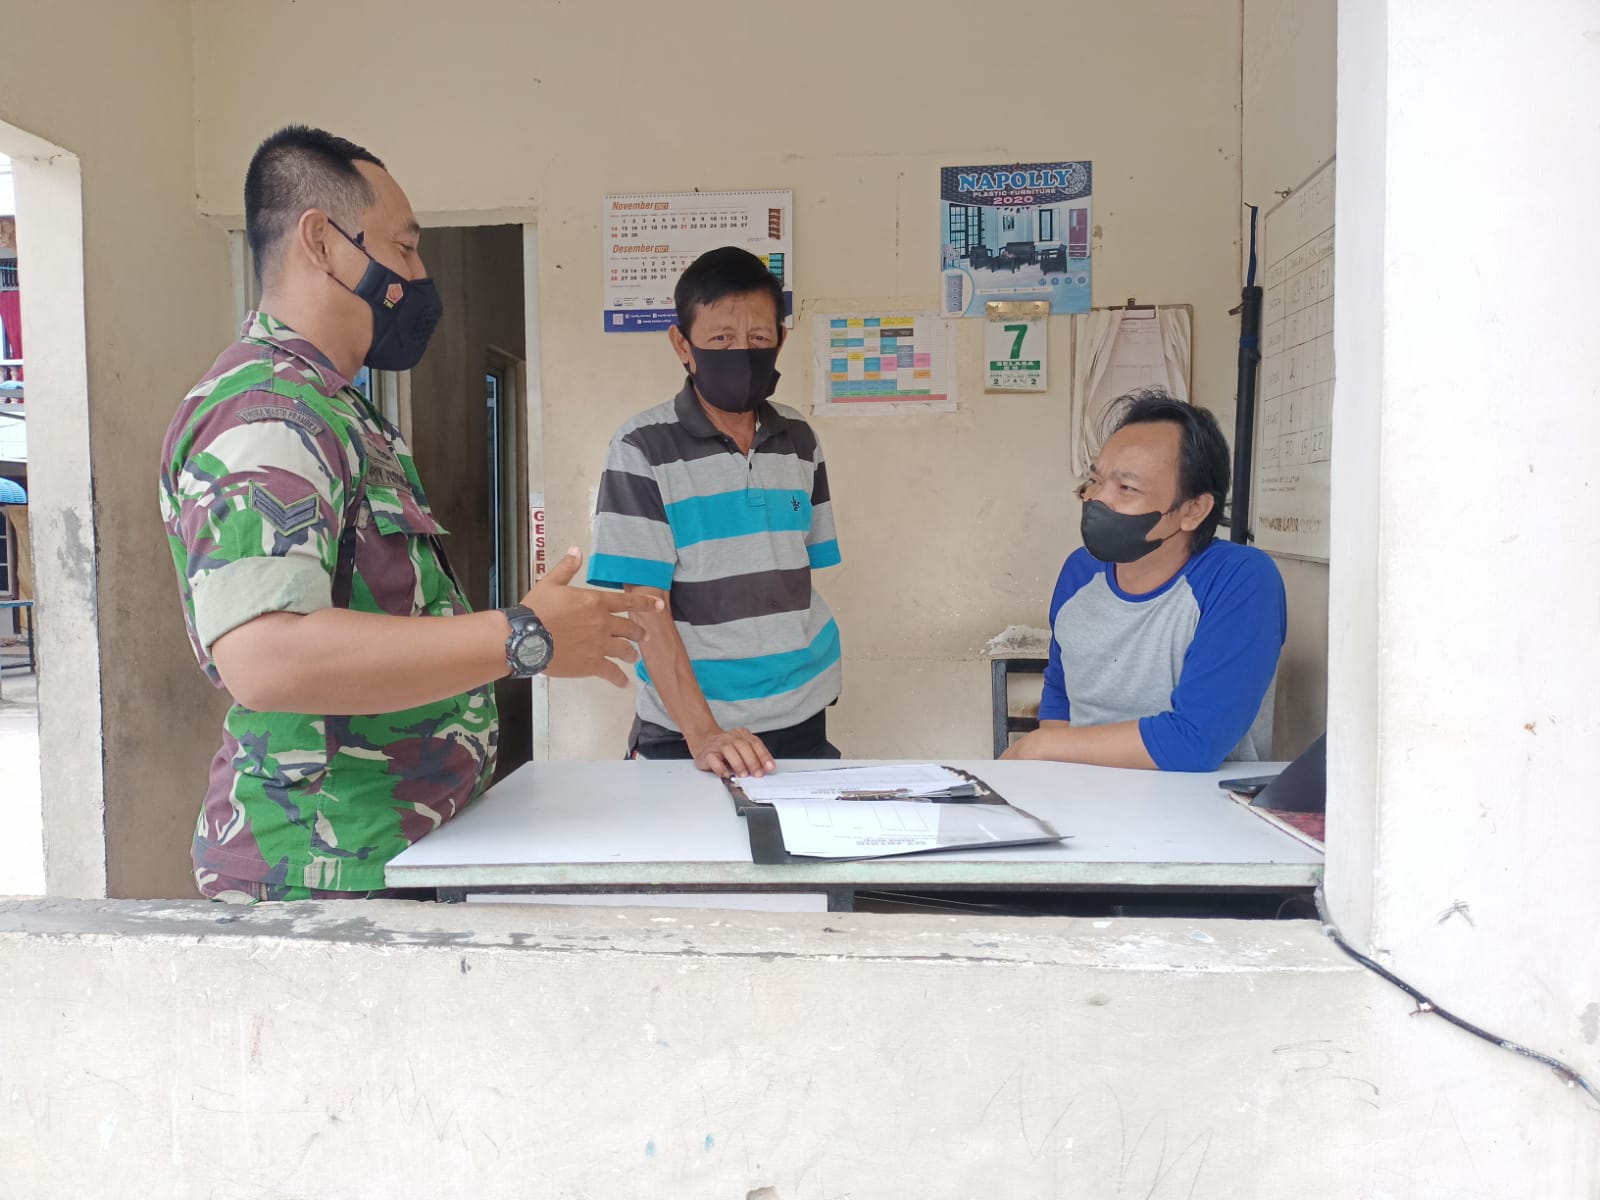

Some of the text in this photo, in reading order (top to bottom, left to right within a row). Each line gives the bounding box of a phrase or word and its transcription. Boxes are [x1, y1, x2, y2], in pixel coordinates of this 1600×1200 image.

[958, 169, 1073, 192] NAPOLLY
[973, 187, 1057, 198] PLASTIC FURNITURE
[611, 201, 653, 210] November
[993, 195, 1034, 205] 2020
[612, 244, 653, 253] Desember
[1004, 324, 1028, 359] 7
[534, 511, 546, 574] GESER
